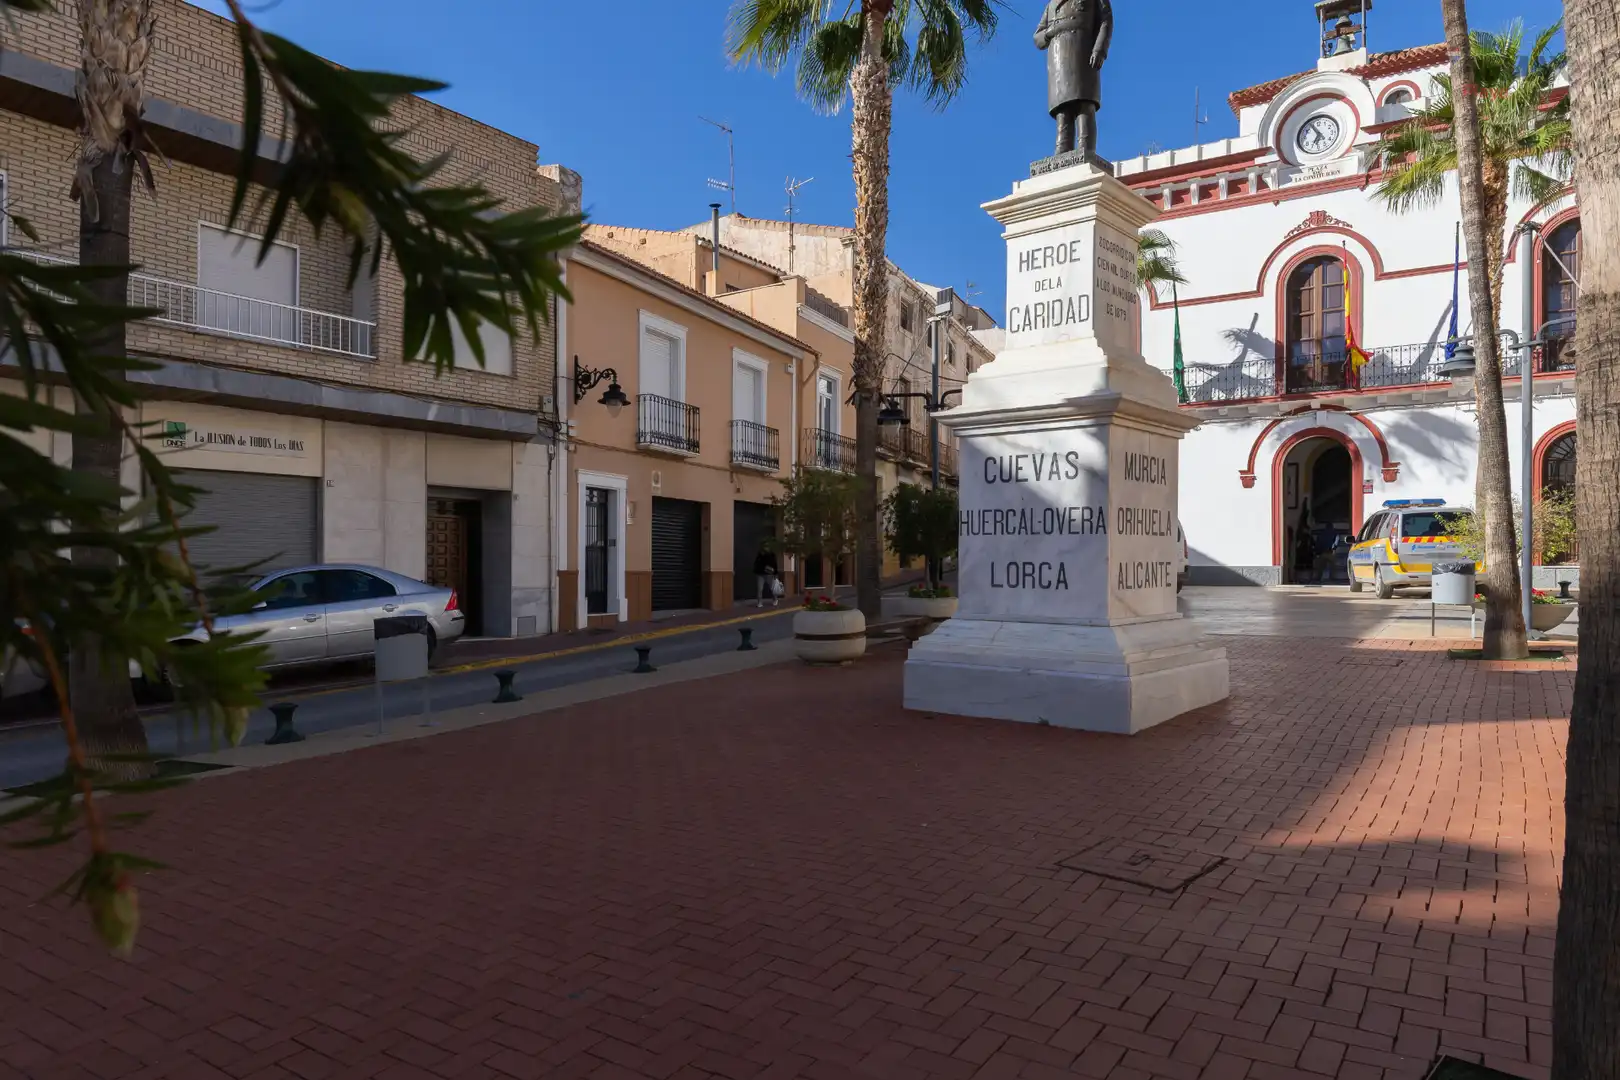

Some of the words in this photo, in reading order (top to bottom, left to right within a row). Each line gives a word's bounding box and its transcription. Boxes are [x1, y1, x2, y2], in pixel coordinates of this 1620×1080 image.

[1019, 239, 1081, 273] HEROE
[1009, 294, 1090, 334] CARIDAD
[194, 431, 205, 443] La
[237, 435, 247, 447] de
[249, 435, 273, 449] TODOS
[274, 438, 287, 450] Los
[984, 450, 1079, 484] CUEVAS
[1124, 451, 1167, 486] MURCIA
[959, 505, 1107, 537] HUERCAL-OVERA
[1117, 507, 1172, 537] ORIHUELA
[990, 561, 1069, 590] LORCA
[1117, 561, 1172, 591] ALICANTE
